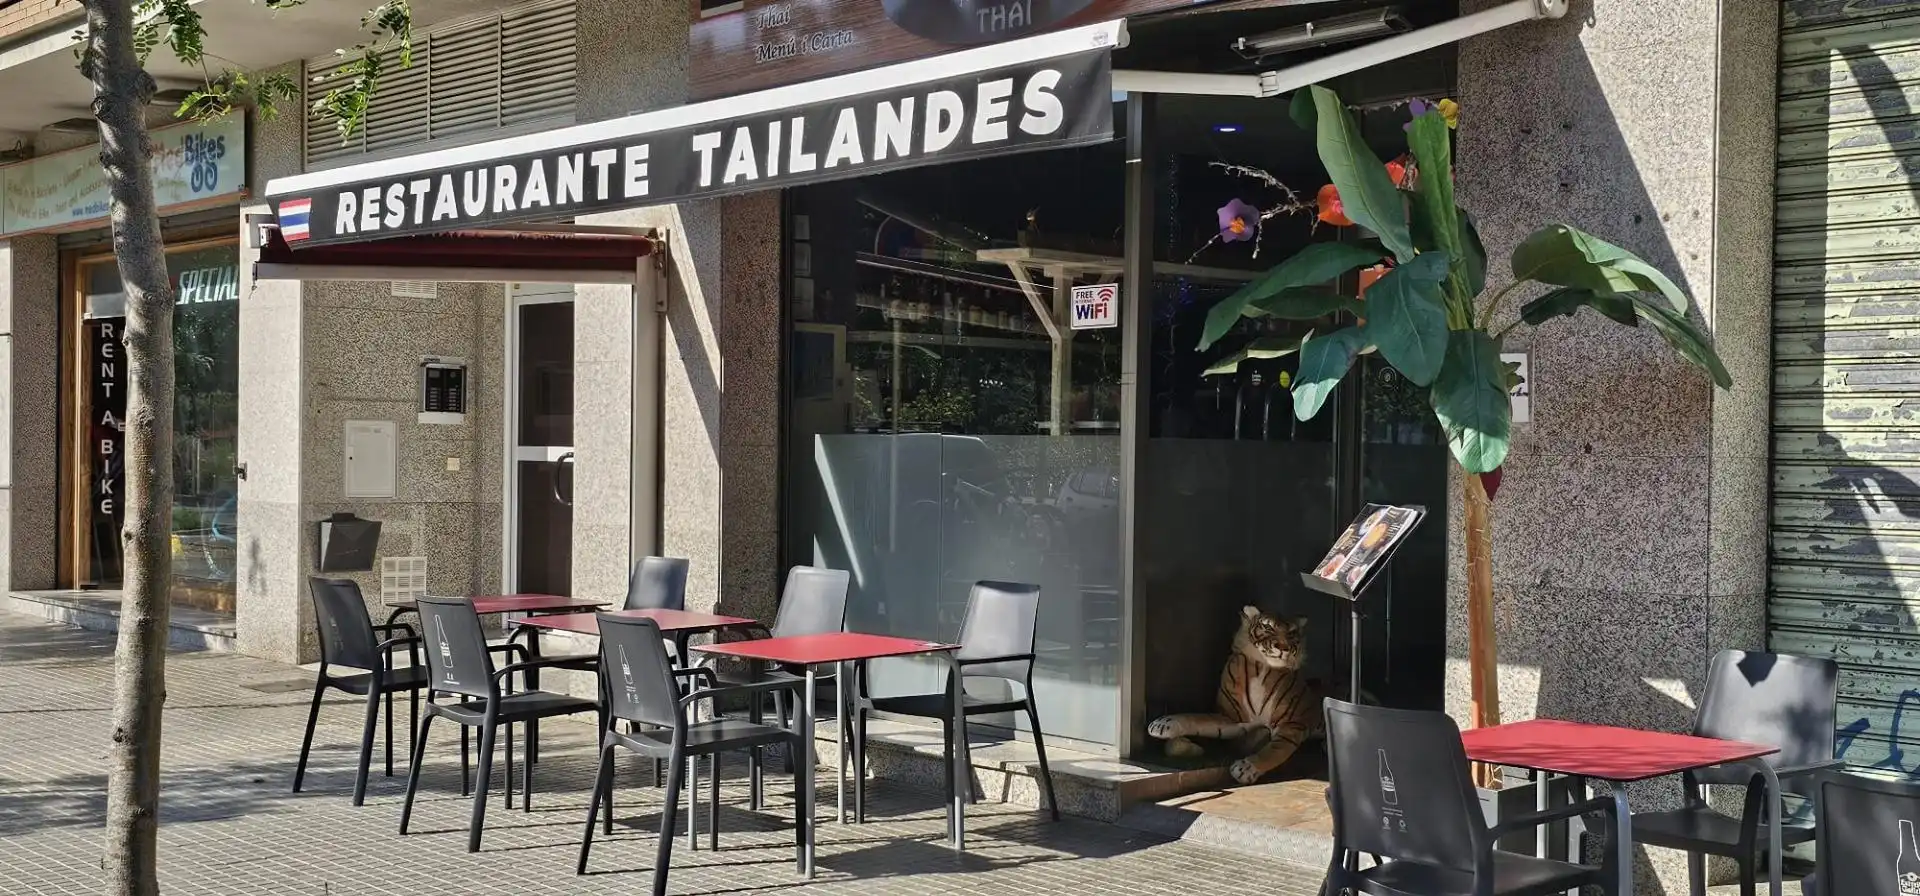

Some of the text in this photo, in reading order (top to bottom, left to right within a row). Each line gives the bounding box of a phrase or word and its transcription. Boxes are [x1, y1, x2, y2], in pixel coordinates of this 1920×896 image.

[756, 4, 791, 30] Thai
[976, 0, 1032, 33] THAI
[755, 33, 796, 63] Menú
[811, 29, 853, 53] Carta
[335, 68, 1064, 235] RESTAURANTE TAILANDES
[1075, 290, 1094, 299] FREE
[1075, 302, 1108, 320] WiFi
[101, 322, 115, 515] RENT A BIKE
